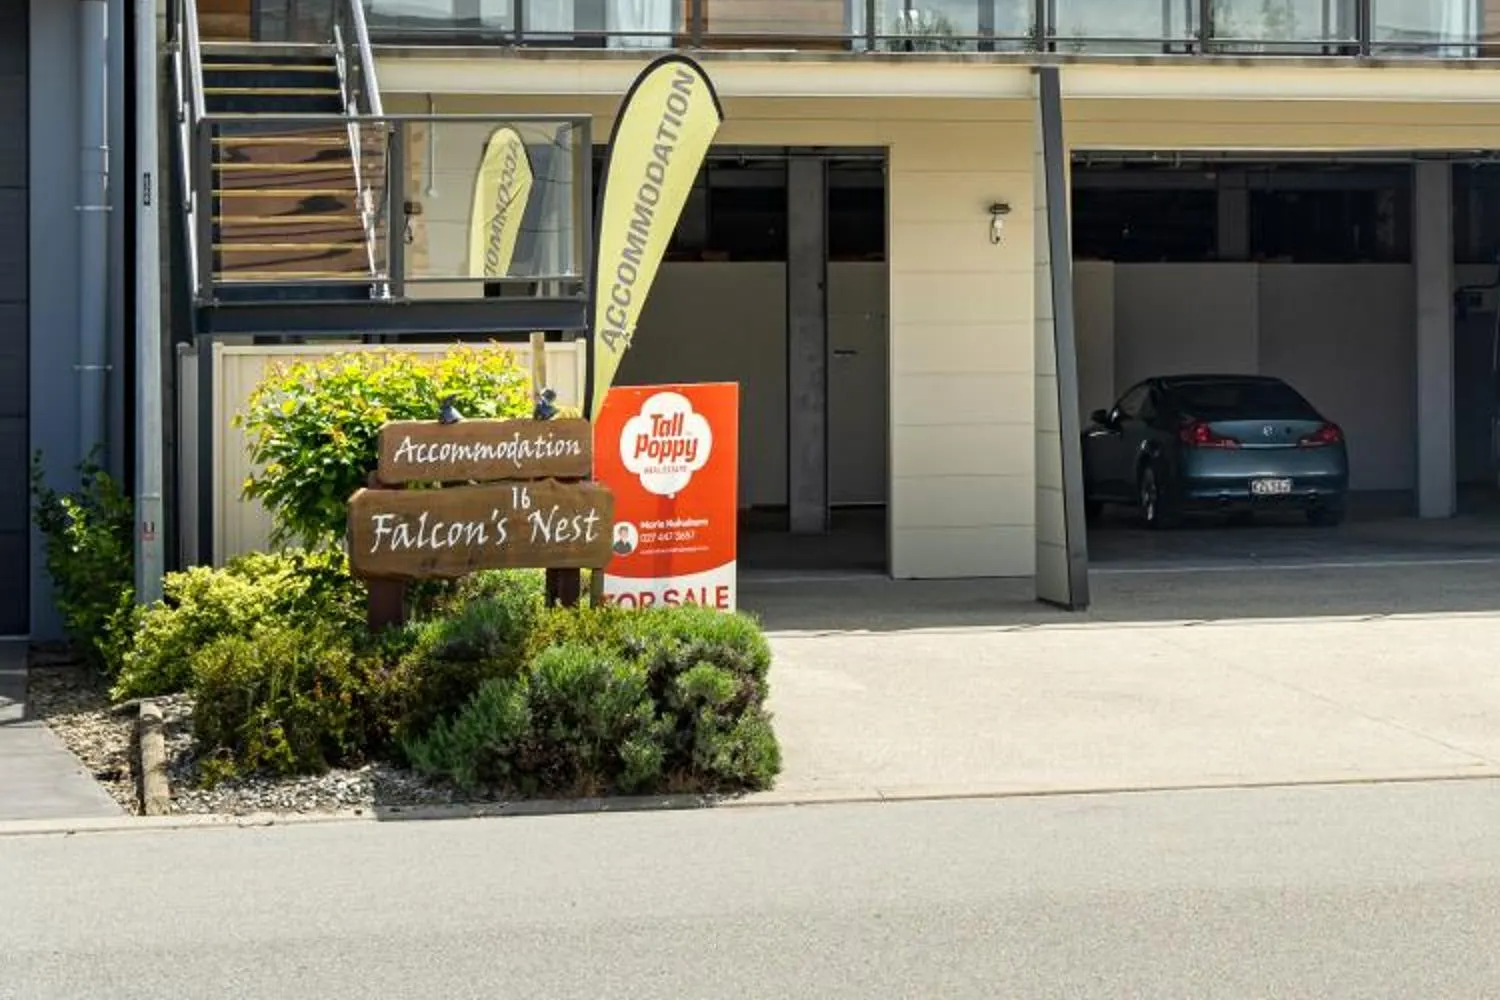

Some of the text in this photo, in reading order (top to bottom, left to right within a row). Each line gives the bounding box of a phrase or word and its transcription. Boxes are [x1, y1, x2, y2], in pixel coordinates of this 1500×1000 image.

[600, 69, 696, 353] ACCOMMODATION
[650, 411, 685, 438] Tall
[393, 431, 582, 469] Accommodation
[633, 432, 699, 464] Poppy
[512, 486, 531, 510] 16
[370, 504, 600, 552] Falcon's Nest
[604, 592, 656, 610] OR
